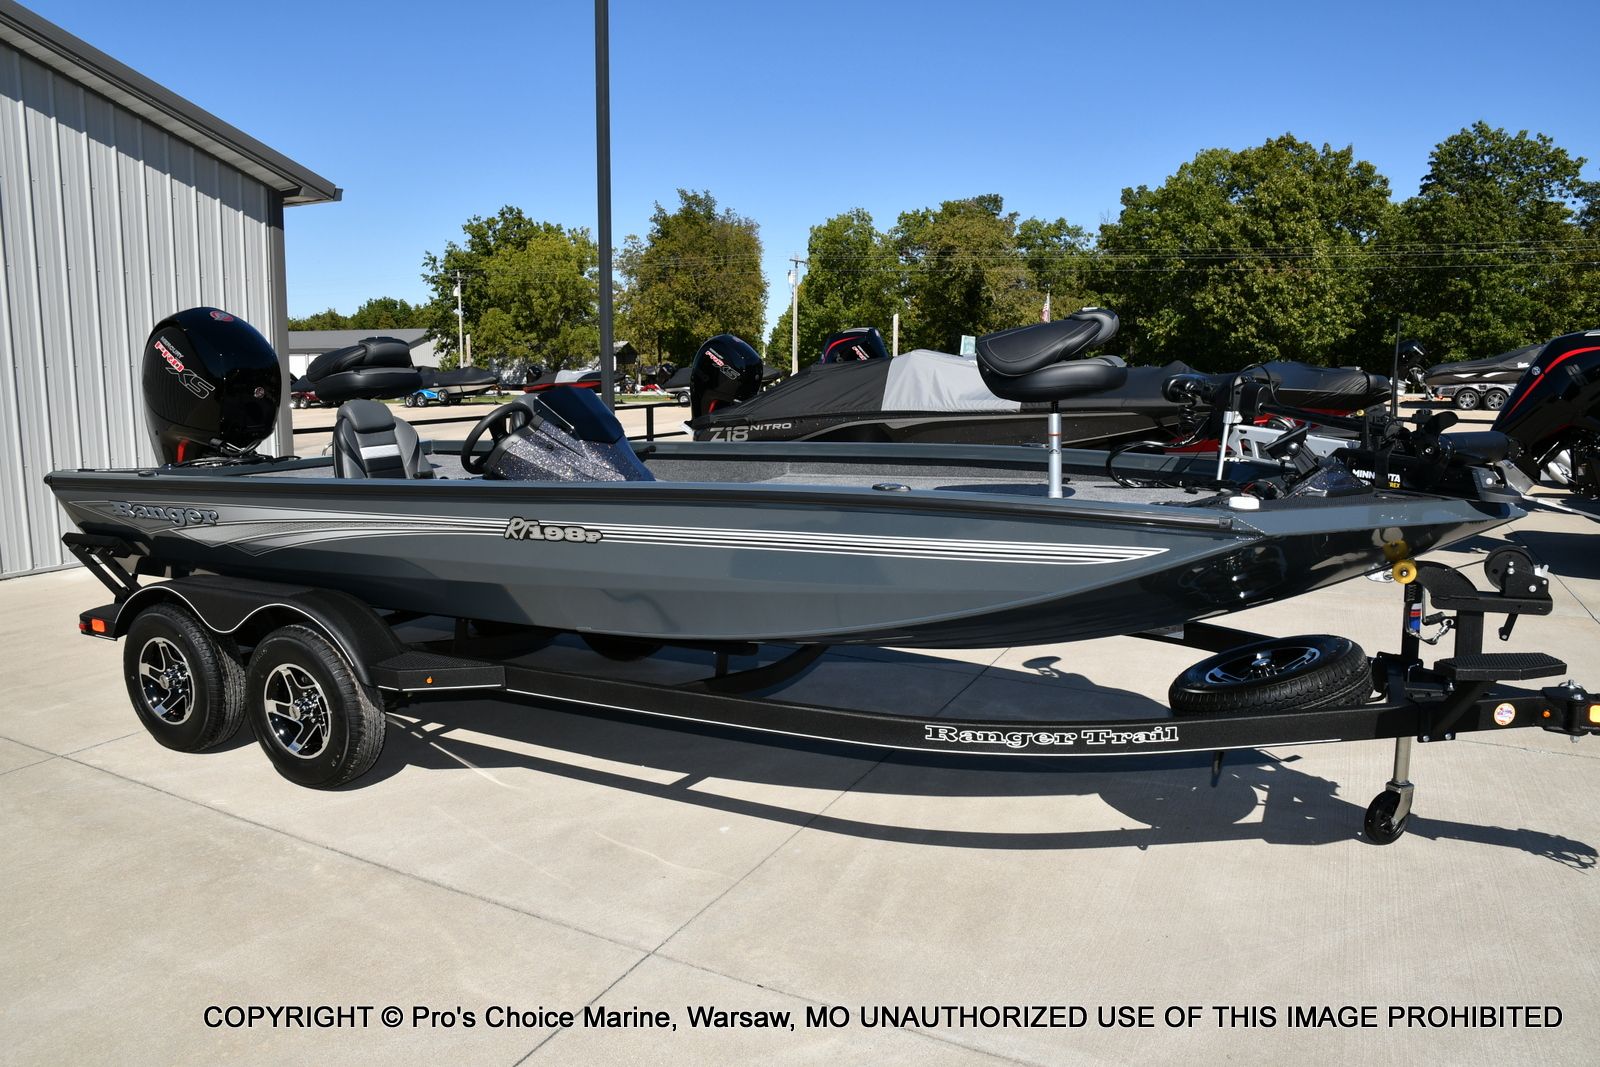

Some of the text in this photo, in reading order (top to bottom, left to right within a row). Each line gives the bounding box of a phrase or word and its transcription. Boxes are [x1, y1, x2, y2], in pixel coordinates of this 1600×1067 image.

[154, 340, 216, 399] PRO XS
[709, 422, 792, 442] Z18 NITRO
[1352, 469, 1376, 479] MINN
[109, 500, 219, 527] Ranger
[924, 724, 1180, 749] Ranger Trail
